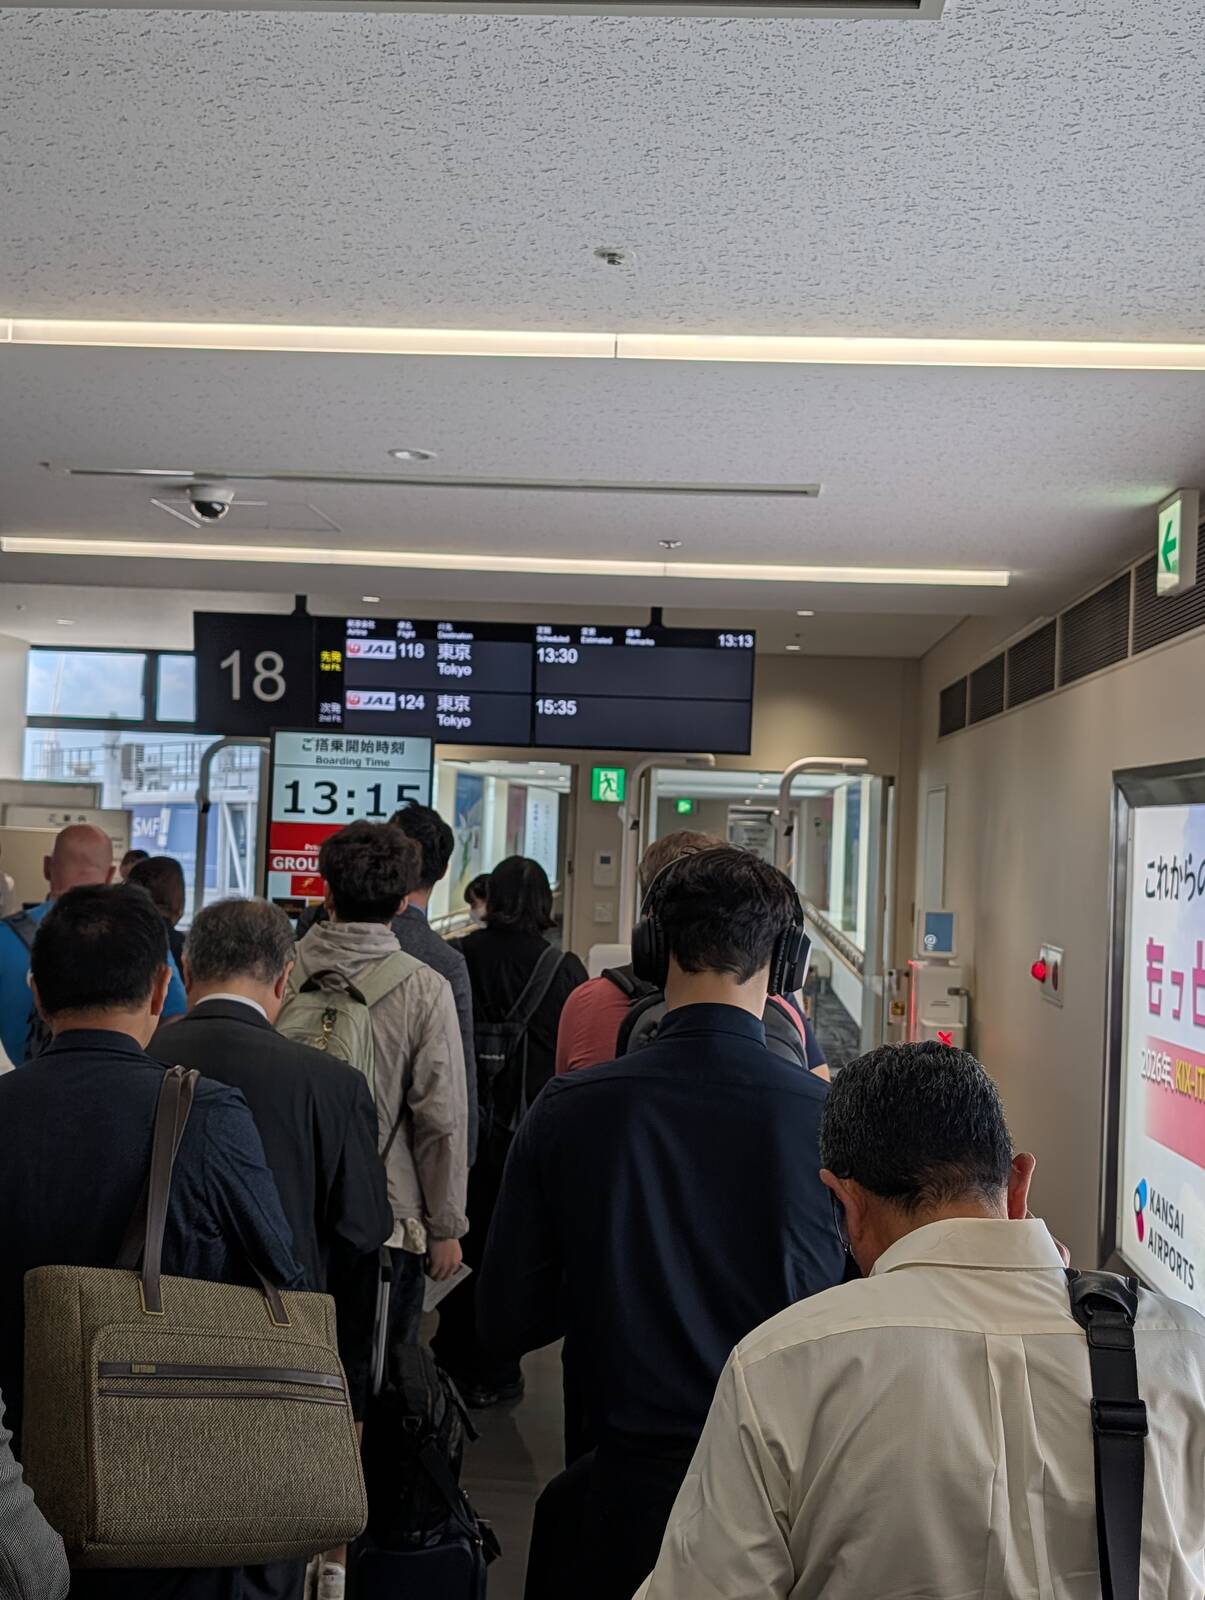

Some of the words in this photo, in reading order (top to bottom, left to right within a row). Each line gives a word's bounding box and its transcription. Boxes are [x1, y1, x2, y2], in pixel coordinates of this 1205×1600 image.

[718, 634, 754, 648] 13:13
[364, 644, 394, 655] JAL
[399, 643, 425, 659] 118
[437, 643, 472, 661] 東京
[537, 647, 578, 664] 13:30
[220, 649, 287, 702] 18
[437, 662, 472, 678] Tokyo
[364, 695, 394, 706] JAL
[399, 694, 425, 710] 124
[437, 694, 471, 712] 東京
[536, 699, 577, 716] 15:35
[437, 713, 471, 729] Tokyo
[301, 738, 406, 755] ご搭乗開始時刻
[315, 755, 362, 768] Boarding
[365, 757, 390, 767] Time
[283, 779, 421, 817] 13:15
[272, 856, 319, 872] GROU
[1149, 1187, 1184, 1239] KANSAI
[1148, 1227, 1194, 1290] AIRPORTS
